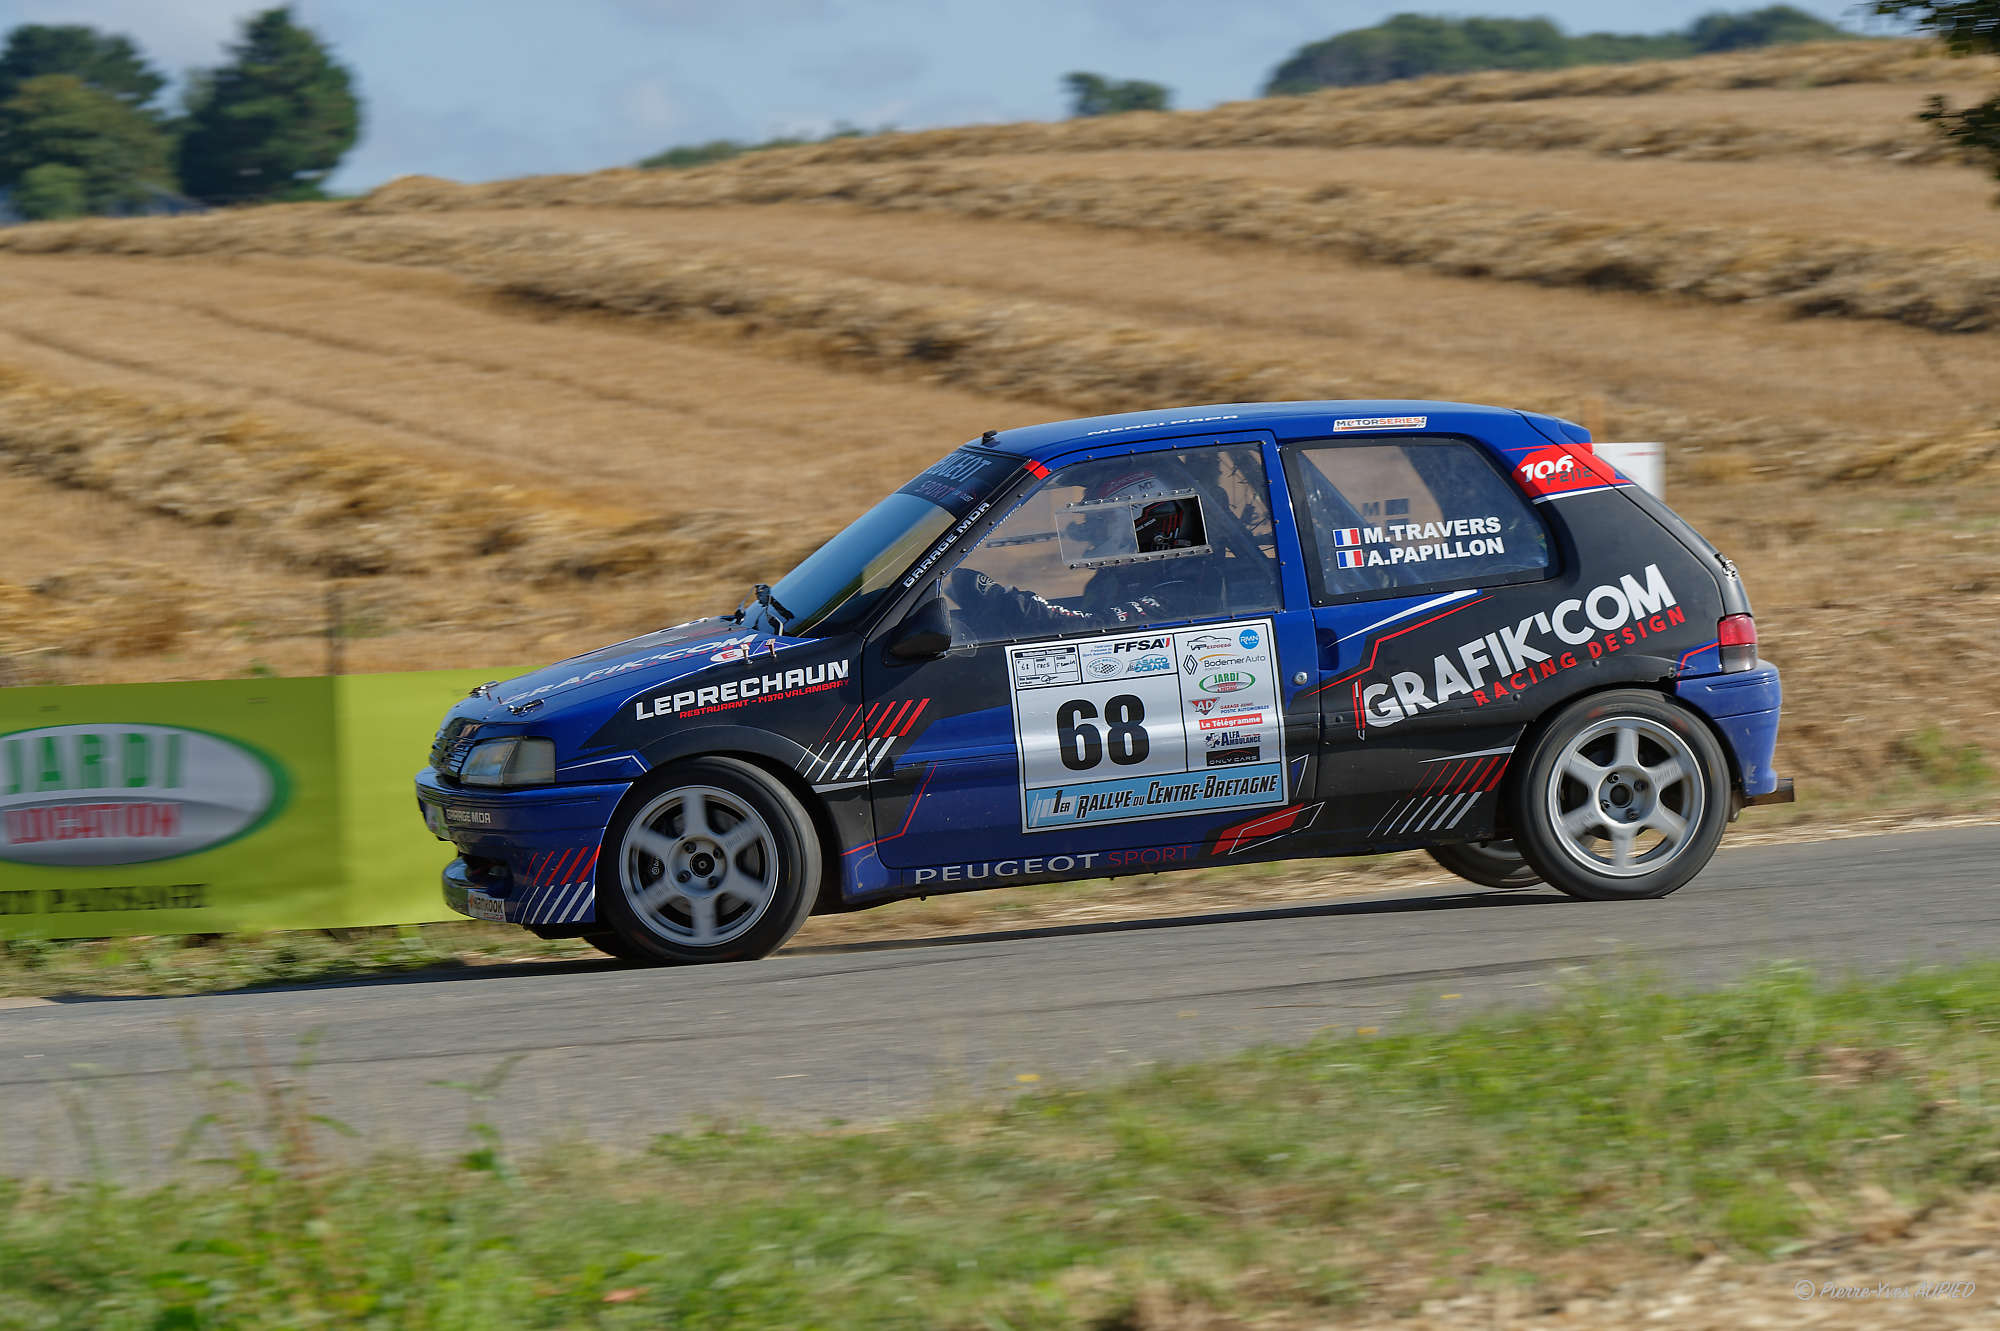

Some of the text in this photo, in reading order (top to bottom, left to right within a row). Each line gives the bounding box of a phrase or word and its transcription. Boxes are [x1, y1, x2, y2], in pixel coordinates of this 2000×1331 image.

[1520, 454, 1574, 483] 106
[903, 501, 991, 588] GARAGE MDA
[1363, 516, 1501, 544] M.TRAVERS
[1367, 536, 1505, 567] A.PAPILLON
[1113, 638, 1165, 654] FFSA
[1361, 563, 1677, 728] GRAFIK'COM
[1472, 605, 1686, 708] RACING DESIGN
[635, 659, 850, 721] LEPRECHAUN
[1213, 672, 1239, 683] JARDI
[679, 698, 750, 720] RESTAURANT
[1195, 700, 1214, 713] AD
[1213, 717, 1261, 727] Télégramme
[1056, 693, 1151, 771] 68
[2, 733, 185, 795] JARDI
[1209, 757, 1233, 765] ONLY
[1075, 790, 1133, 819] RALLYE
[1133, 795, 1145, 807] DU
[1146, 774, 1280, 806] CENTRE-BRETAGNE
[914, 845, 1193, 885] PEUGEOT SPORT
